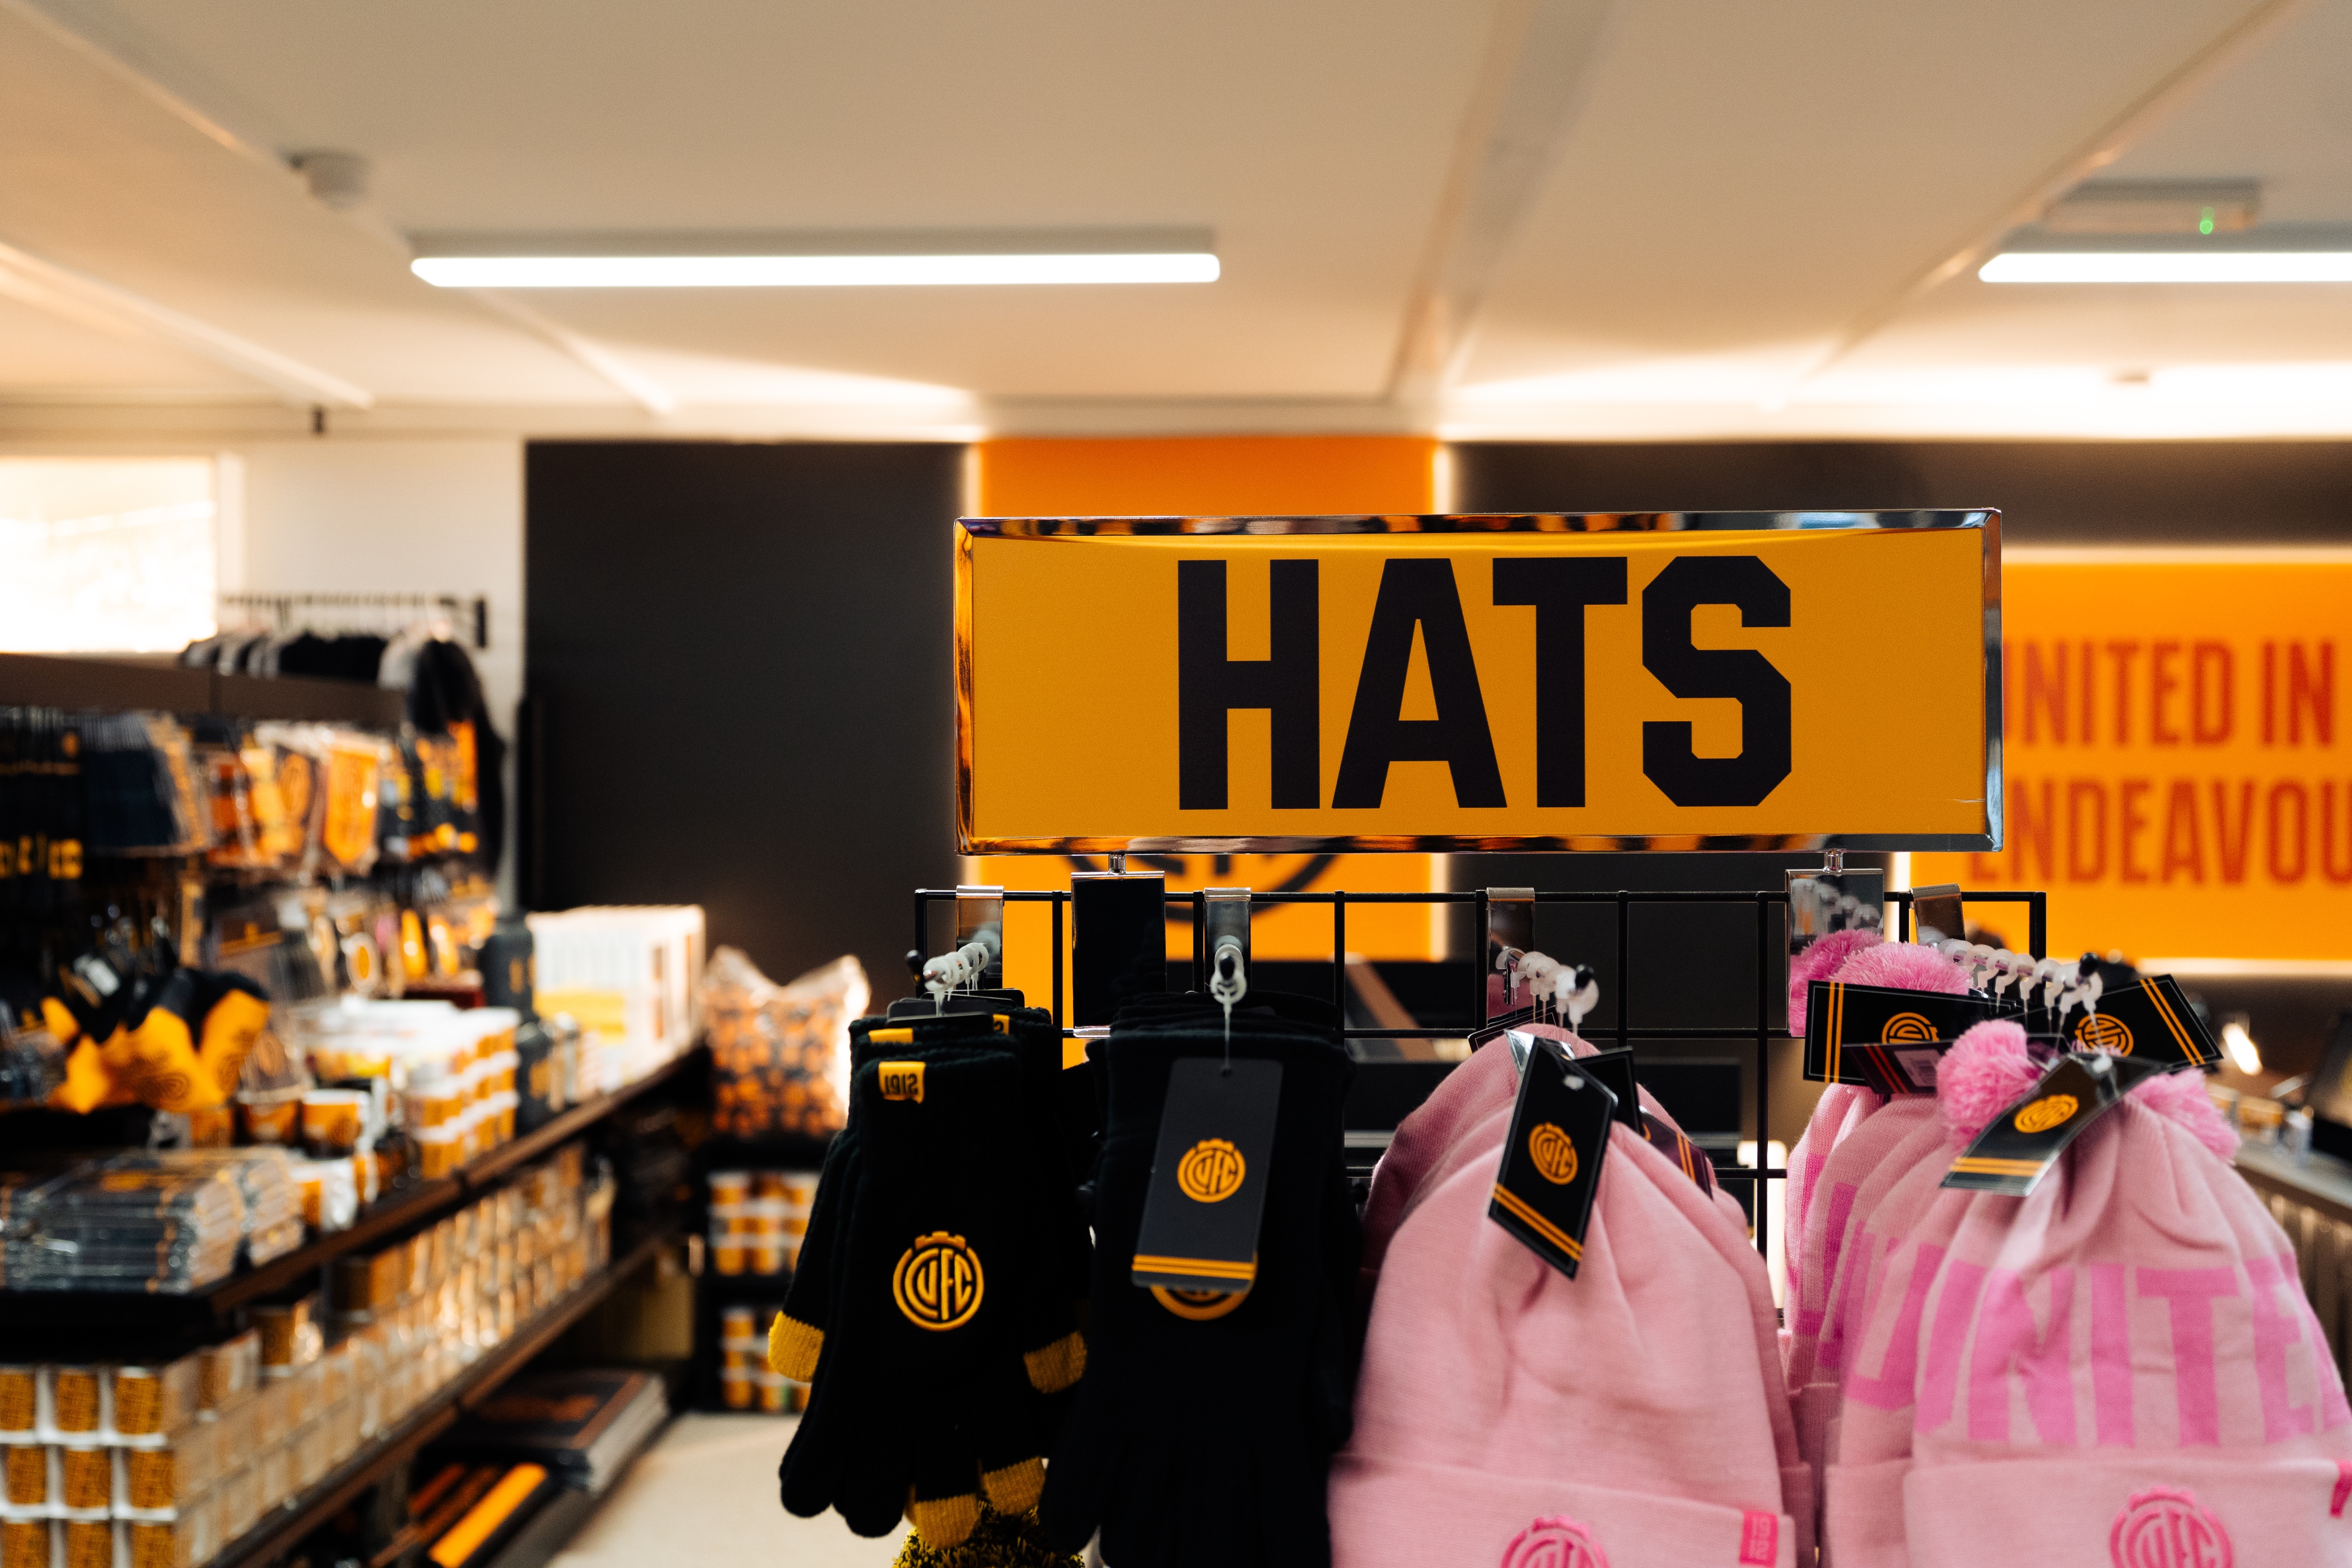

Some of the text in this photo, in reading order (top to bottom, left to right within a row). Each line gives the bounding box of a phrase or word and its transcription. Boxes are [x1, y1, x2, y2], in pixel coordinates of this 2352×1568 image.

[1178, 556, 1792, 810] HATS
[2003, 641, 2334, 745] NITED IN
[884, 1073, 918, 1095] 1912
